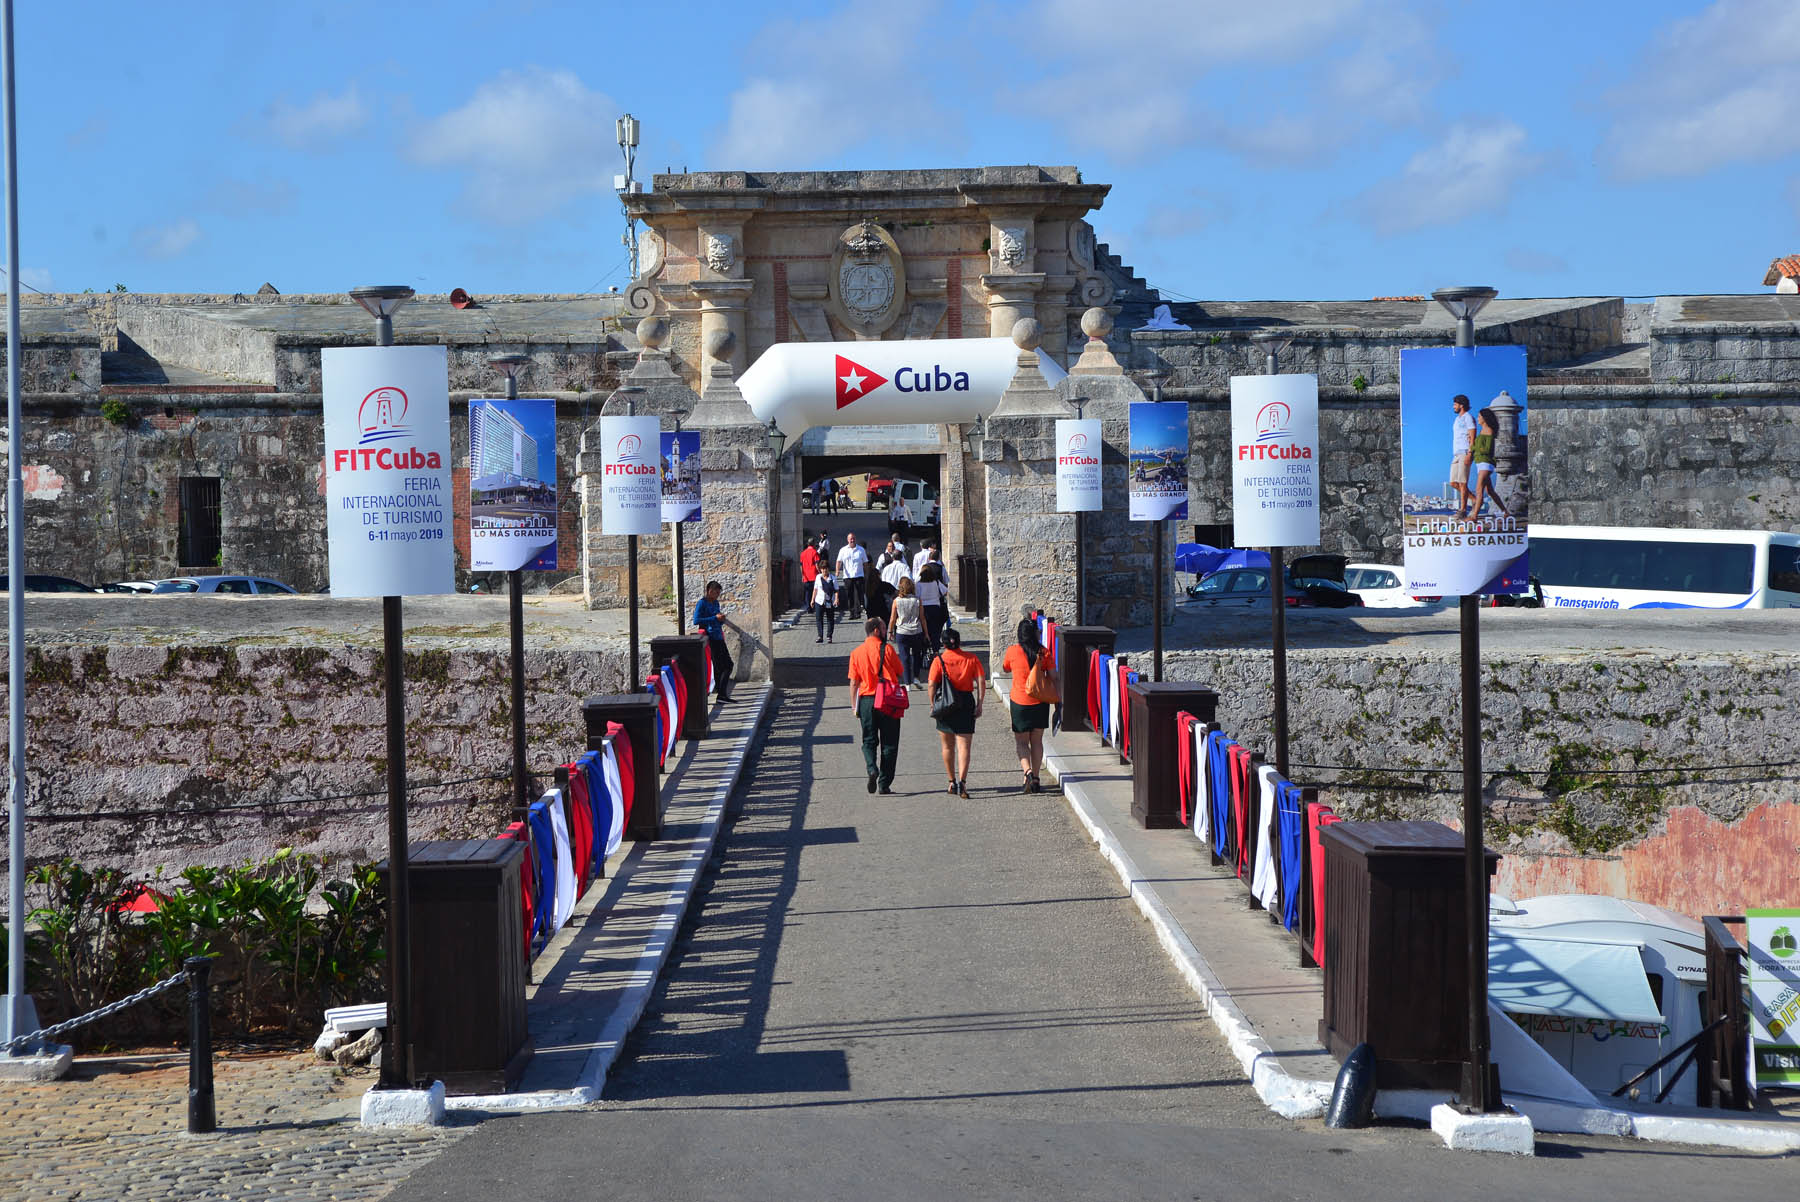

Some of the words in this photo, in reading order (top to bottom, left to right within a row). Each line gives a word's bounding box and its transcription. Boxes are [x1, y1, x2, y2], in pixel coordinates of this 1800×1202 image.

[894, 364, 970, 393] Cuba
[1239, 443, 1312, 460] FITCuba
[334, 447, 441, 471] FITCuba
[1059, 456, 1098, 465] FITCuba
[605, 463, 656, 475] FITCuba
[1287, 464, 1312, 474] FERIA
[404, 477, 441, 491] FERIA
[1244, 476, 1312, 487] INTERNACIONAL
[608, 486, 656, 494] INTERNACIONAL
[1257, 488, 1269, 497] DE
[1272, 487, 1312, 497] TURISMO
[343, 494, 442, 509] INTERNACIONAL
[628, 493, 657, 501] TURISMO
[1296, 500, 1312, 508] 2019
[363, 512, 380, 525] DE
[383, 510, 442, 525] TURISMO
[368, 530, 388, 541] 6-11
[390, 531, 417, 543] mayo
[419, 528, 443, 540] 2019
[513, 529, 554, 537] GRANDE
[1408, 538, 1426, 548] LO
[1432, 535, 1462, 547] MÁS
[1467, 535, 1524, 546] GRANDE
[1555, 596, 1619, 608] Transgaviota
[1763, 987, 1797, 1017] CASA
